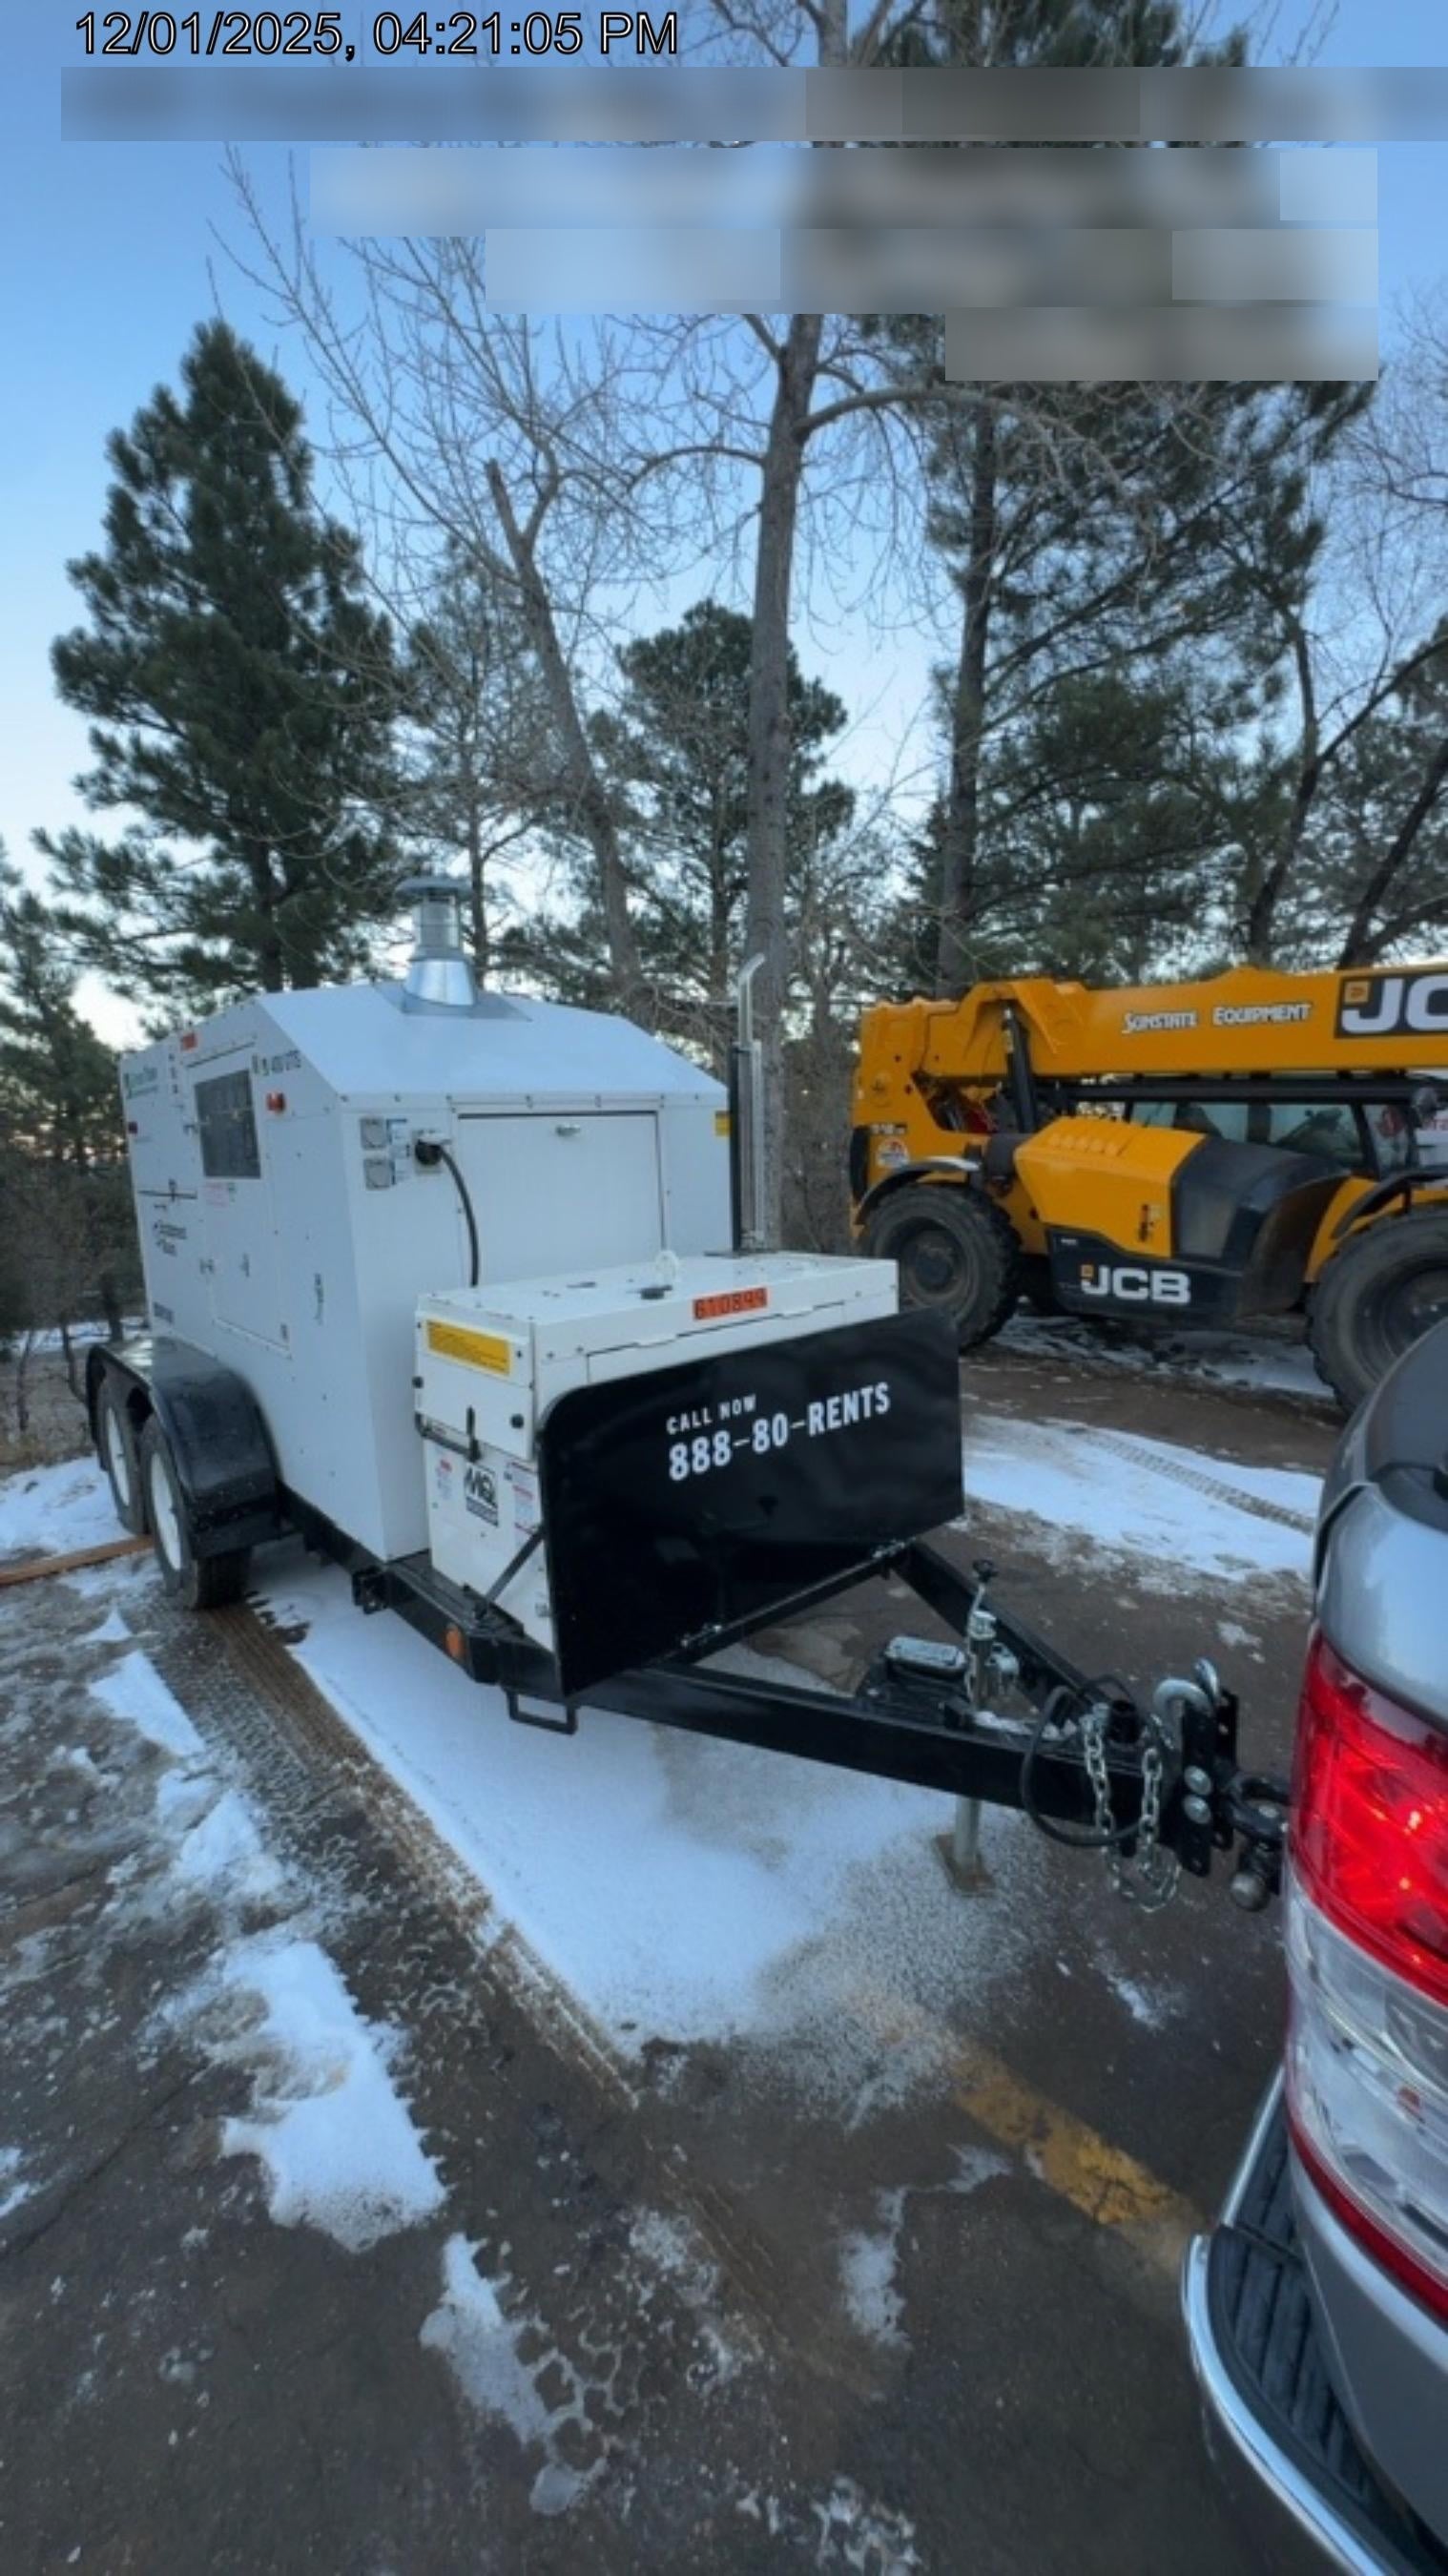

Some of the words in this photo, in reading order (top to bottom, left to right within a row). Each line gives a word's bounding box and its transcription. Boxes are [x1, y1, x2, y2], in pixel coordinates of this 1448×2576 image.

[1212, 1003, 1313, 1026] EQUIPMENT
[1080, 1264, 1191, 1304] JCB
[666, 1407, 713, 1435] CALL
[719, 1393, 757, 1420] NOW
[669, 1381, 891, 1481] 888-80-RENTS
